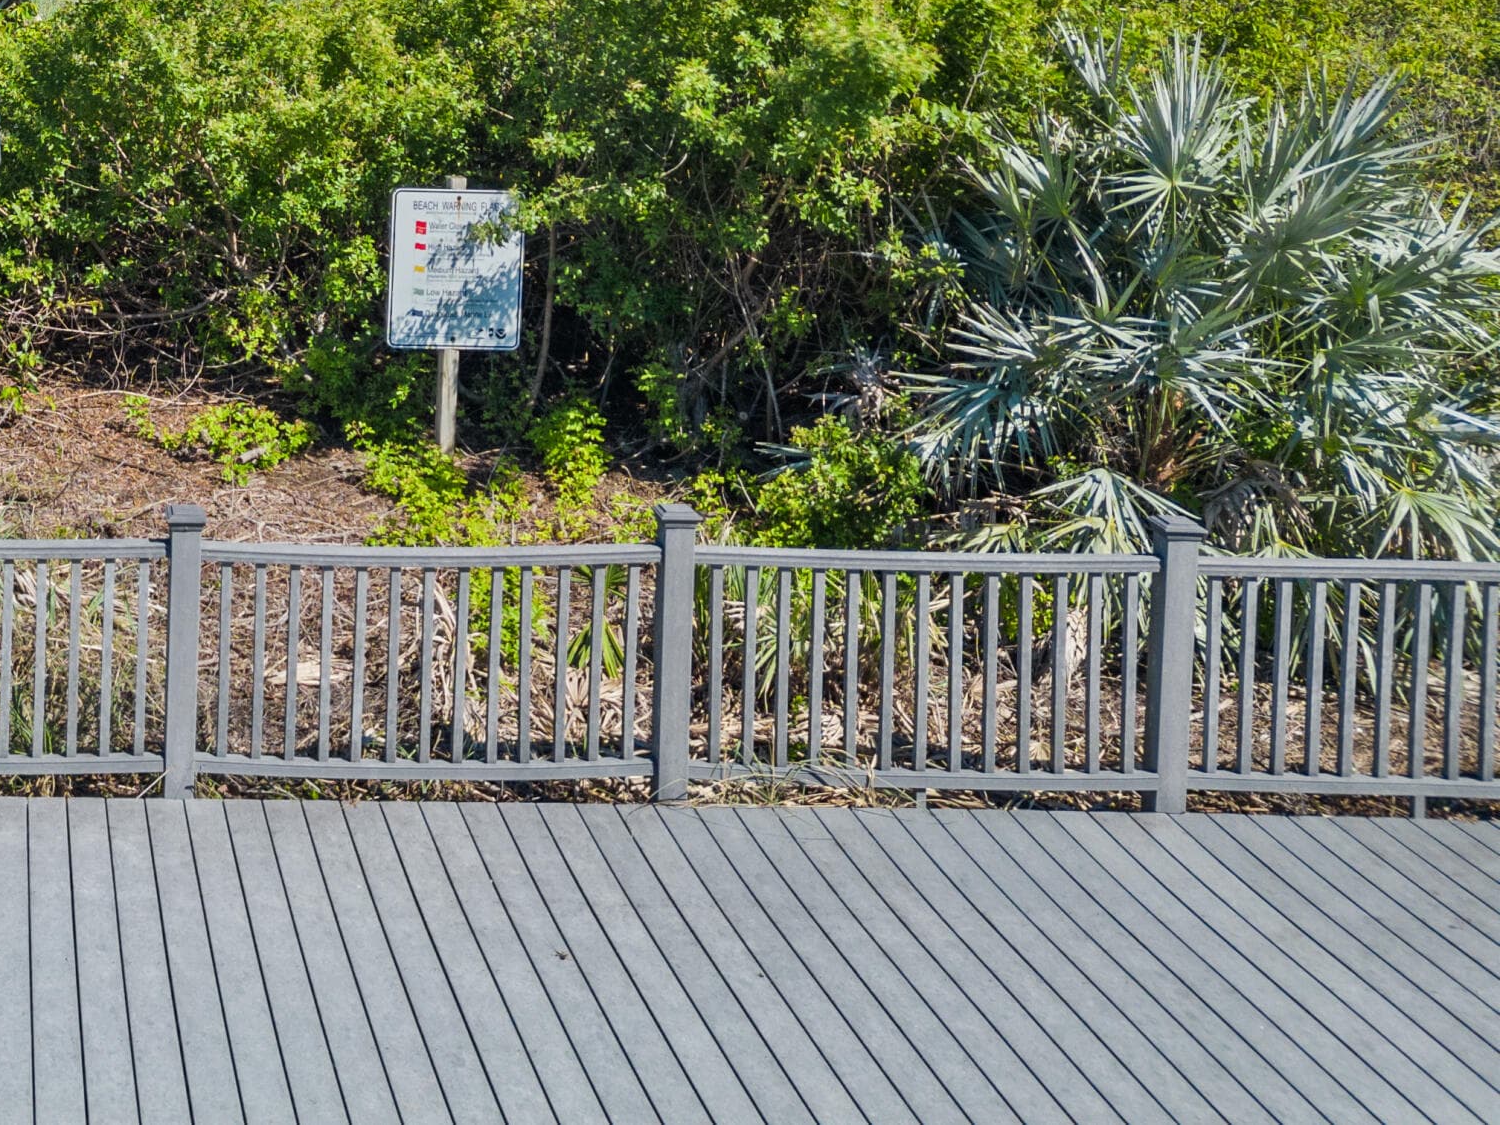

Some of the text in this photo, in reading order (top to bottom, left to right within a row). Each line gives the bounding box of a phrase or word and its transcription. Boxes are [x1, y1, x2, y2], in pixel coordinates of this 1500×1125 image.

[413, 200, 439, 210] BEACH
[442, 201, 477, 212] WARNING
[429, 221, 447, 230] Water
[426, 288, 440, 296] Low
